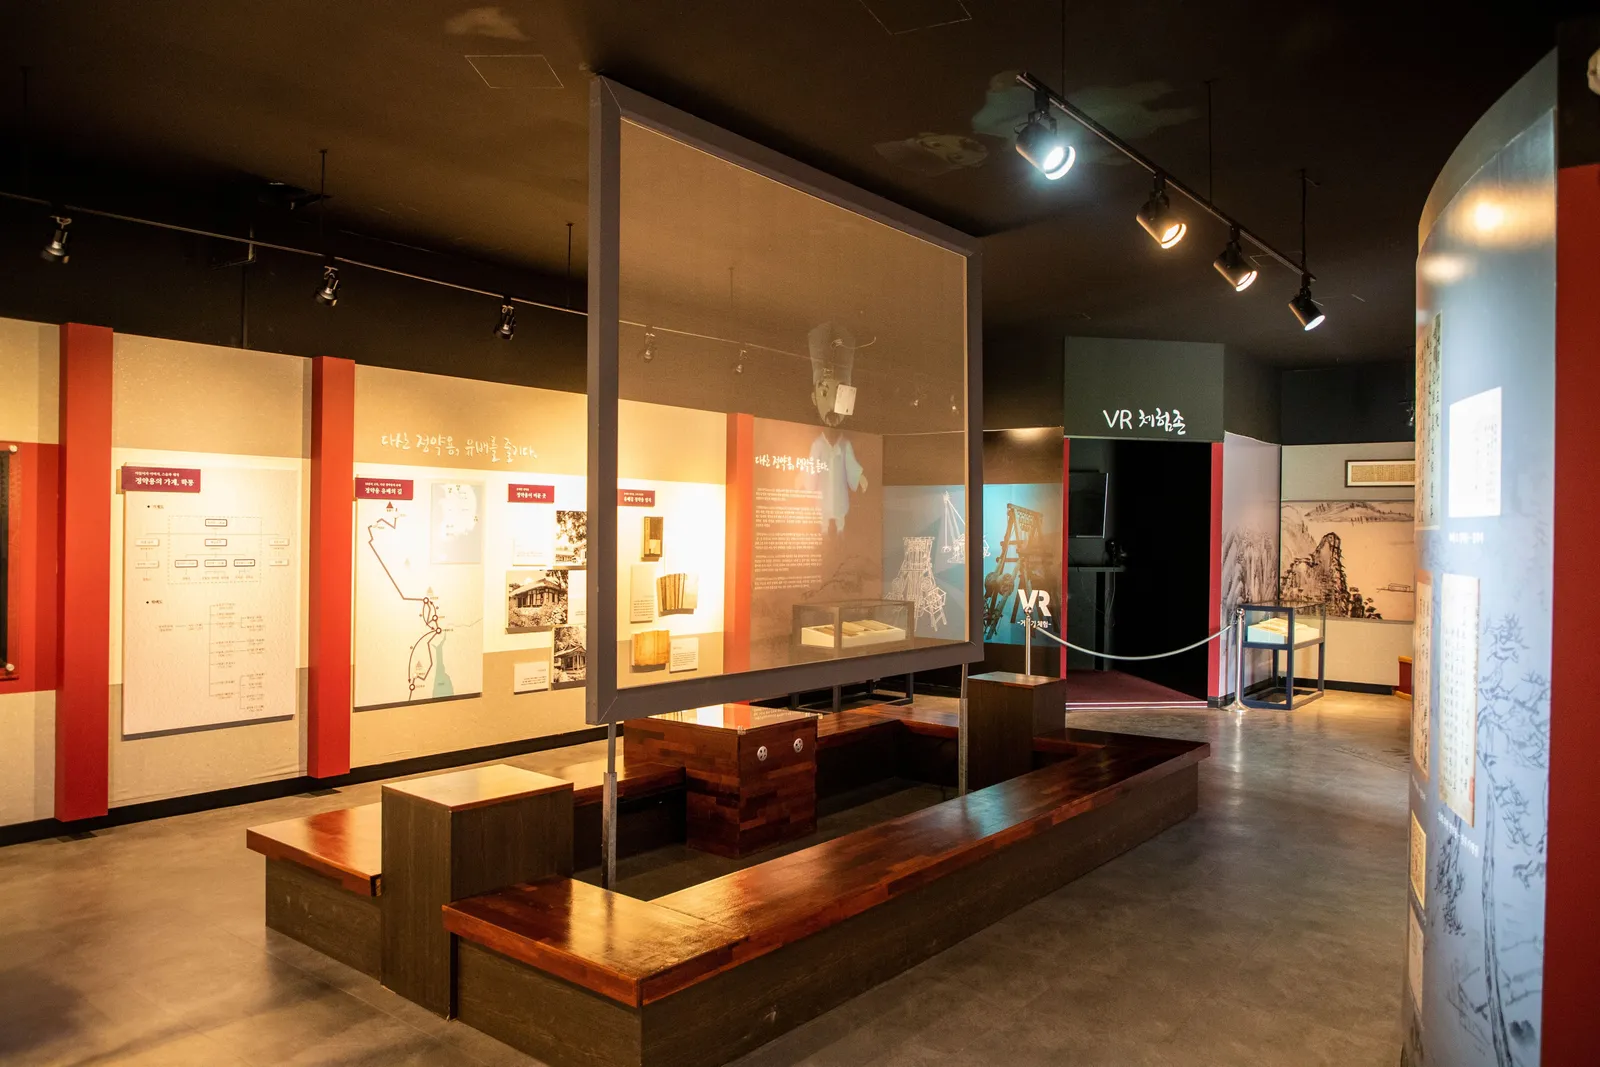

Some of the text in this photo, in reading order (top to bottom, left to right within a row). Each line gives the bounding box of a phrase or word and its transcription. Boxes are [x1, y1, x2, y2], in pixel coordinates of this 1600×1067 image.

[1102, 407, 1186, 435] VR 체험존
[381, 432, 538, 463] 다산 정약용, 유배를 즐기다.
[755, 454, 770, 467] 다산
[772, 455, 795, 471] 정약용,
[135, 477, 163, 485] 정약용의
[1017, 588, 1052, 617] VR
